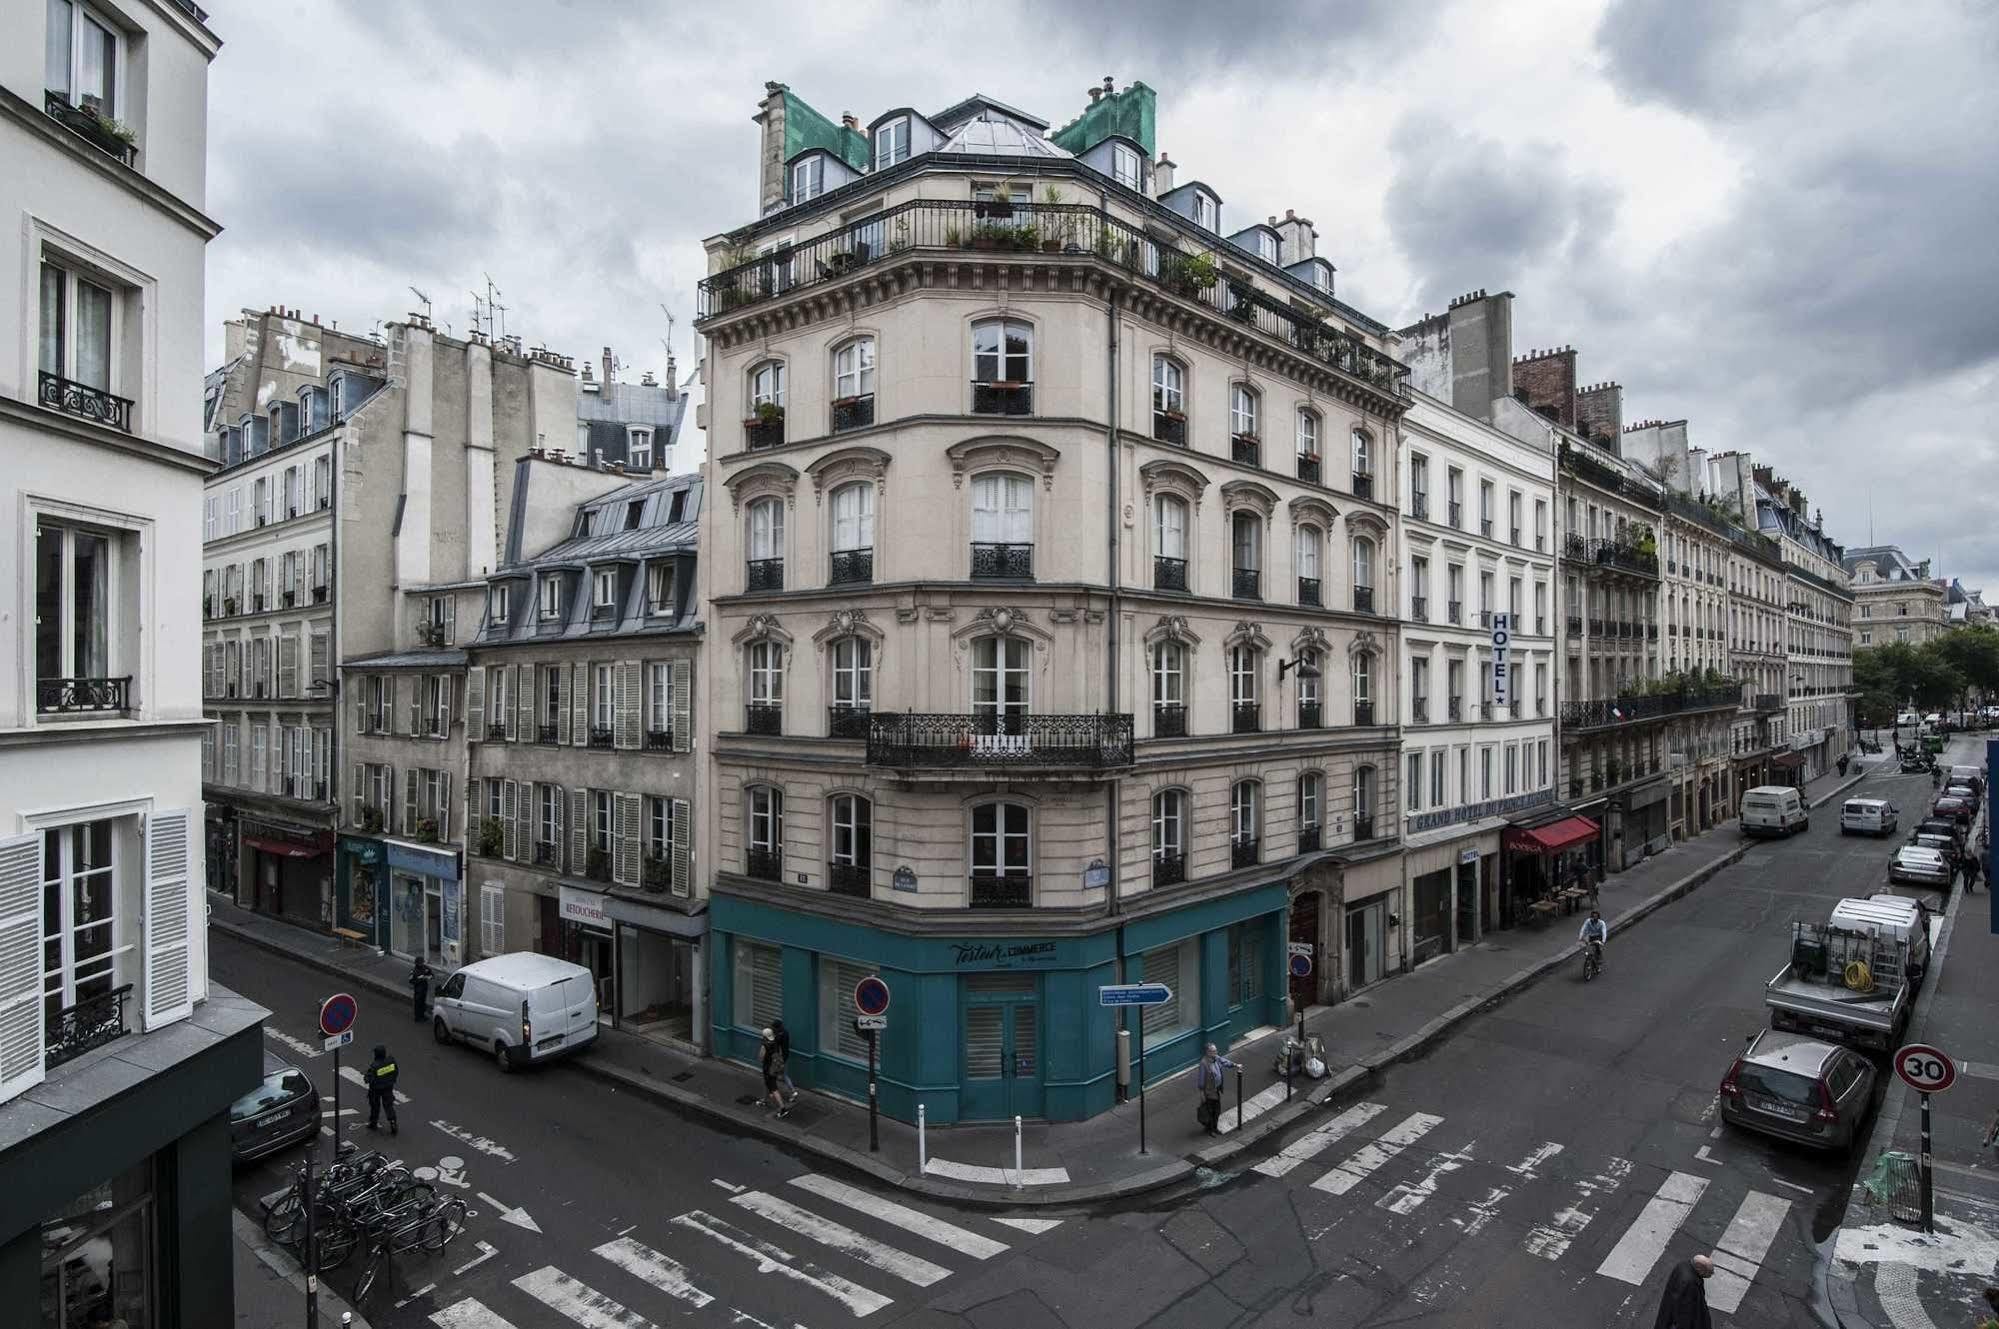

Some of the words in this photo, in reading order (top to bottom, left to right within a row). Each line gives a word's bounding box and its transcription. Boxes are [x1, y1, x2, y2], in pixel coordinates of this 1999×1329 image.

[1493, 615, 1507, 693] HOTEL
[1416, 811, 1450, 829] GRAND
[1486, 801, 1497, 815] DU
[1498, 797, 1524, 813] PRINCE
[1462, 850, 1479, 861] HOTEL
[1907, 1057, 1944, 1081] 30
